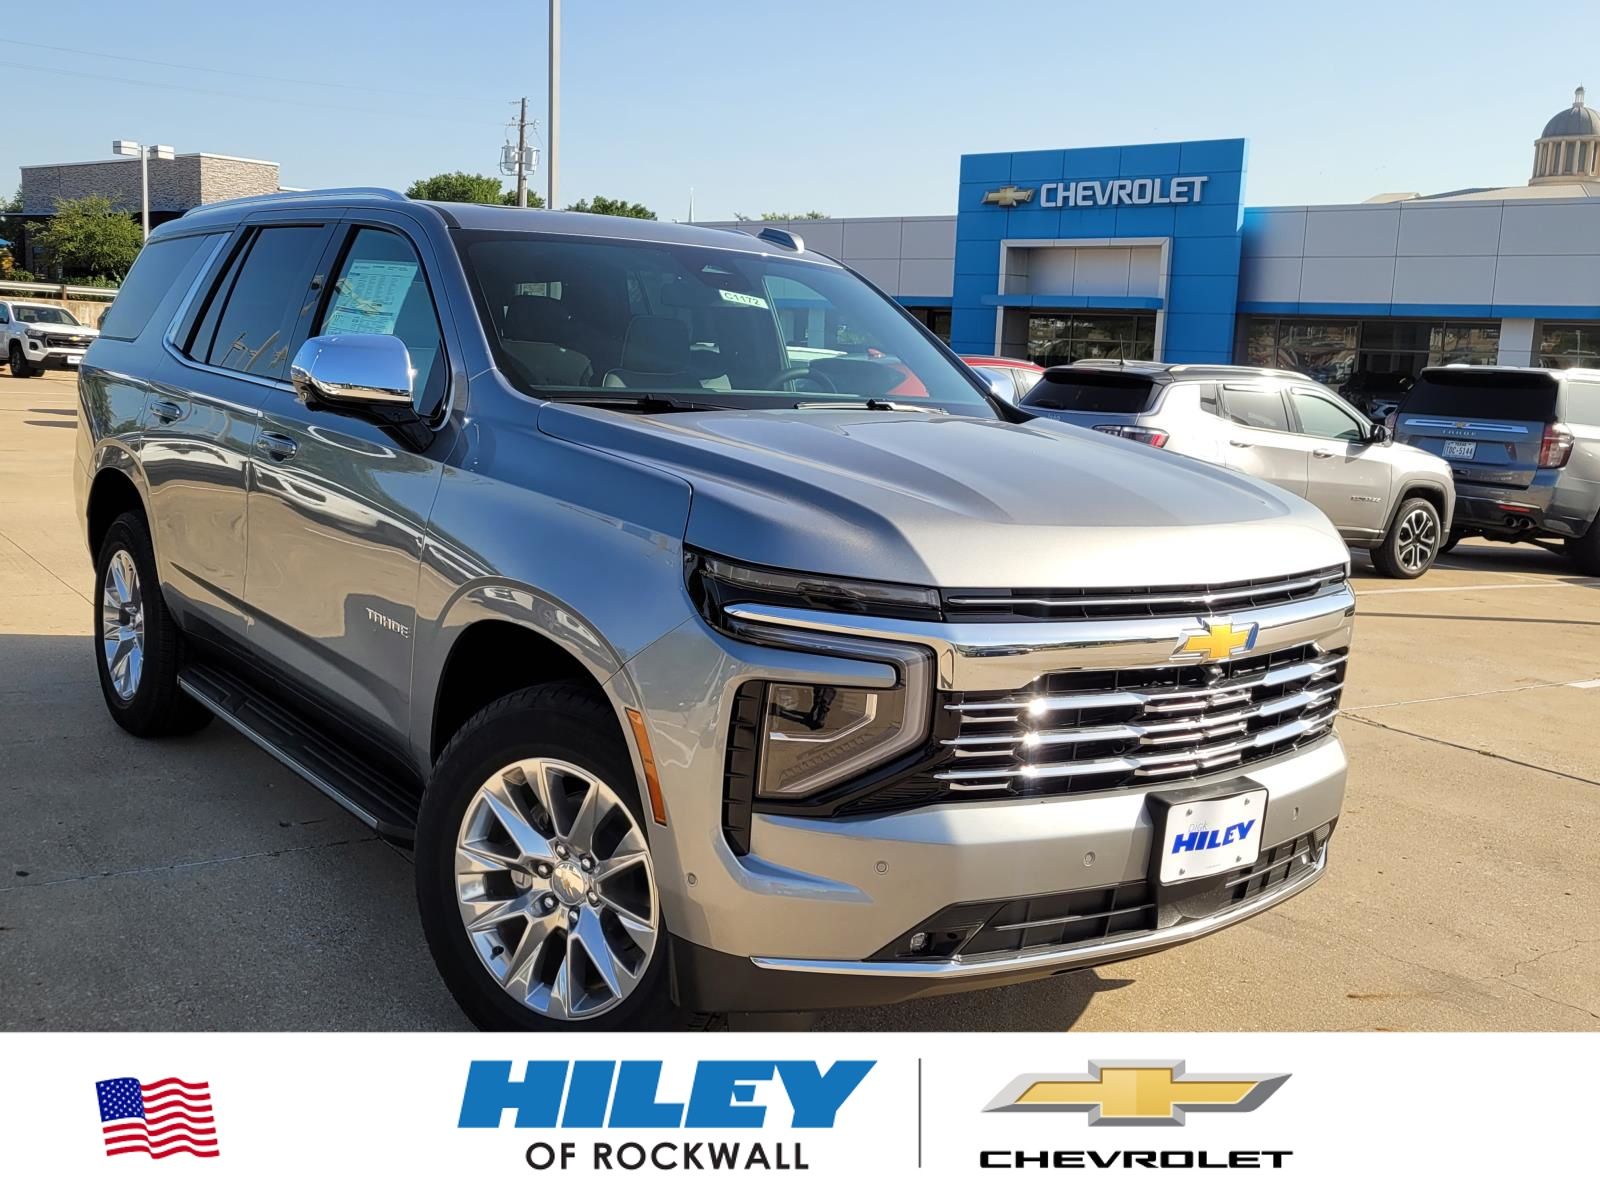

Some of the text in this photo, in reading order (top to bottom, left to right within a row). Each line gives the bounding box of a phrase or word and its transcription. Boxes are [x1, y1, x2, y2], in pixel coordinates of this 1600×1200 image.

[1040, 176, 1209, 208] CHEVROLET
[724, 291, 762, 306] C1172
[365, 607, 409, 639] TAHOE
[1171, 818, 1257, 855] HILEY
